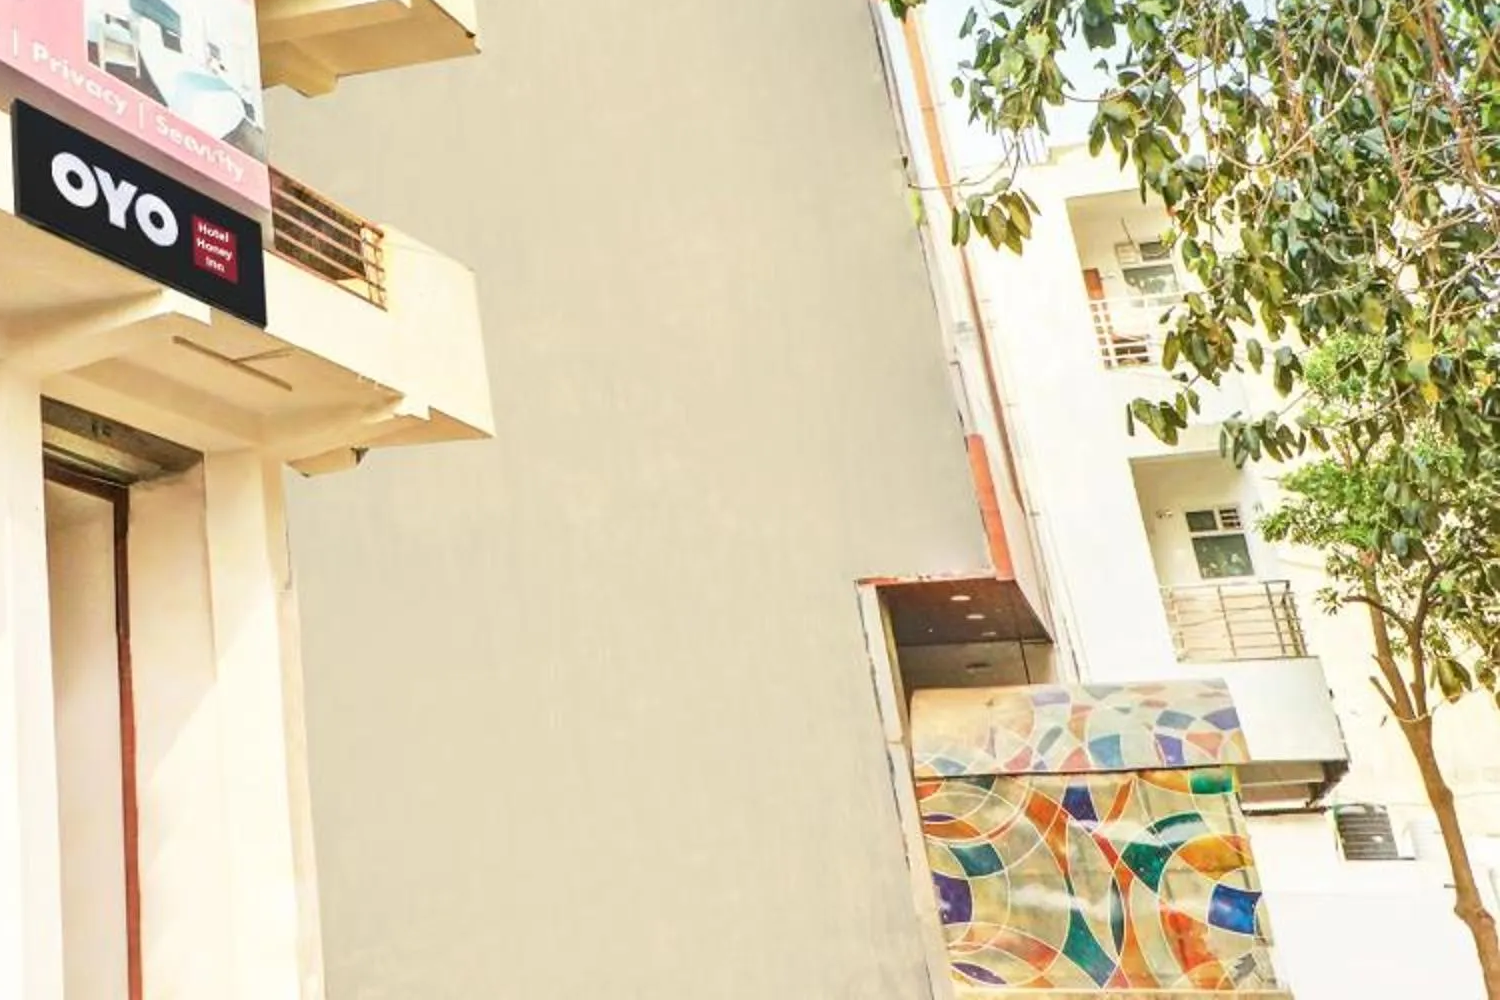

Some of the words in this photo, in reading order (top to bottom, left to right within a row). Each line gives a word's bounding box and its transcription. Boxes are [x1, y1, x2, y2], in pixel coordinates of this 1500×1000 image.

[32, 41, 129, 117] Privacy
[51, 151, 179, 247] OYO
[195, 237, 233, 262] Honey
[197, 221, 229, 243] Hotel
